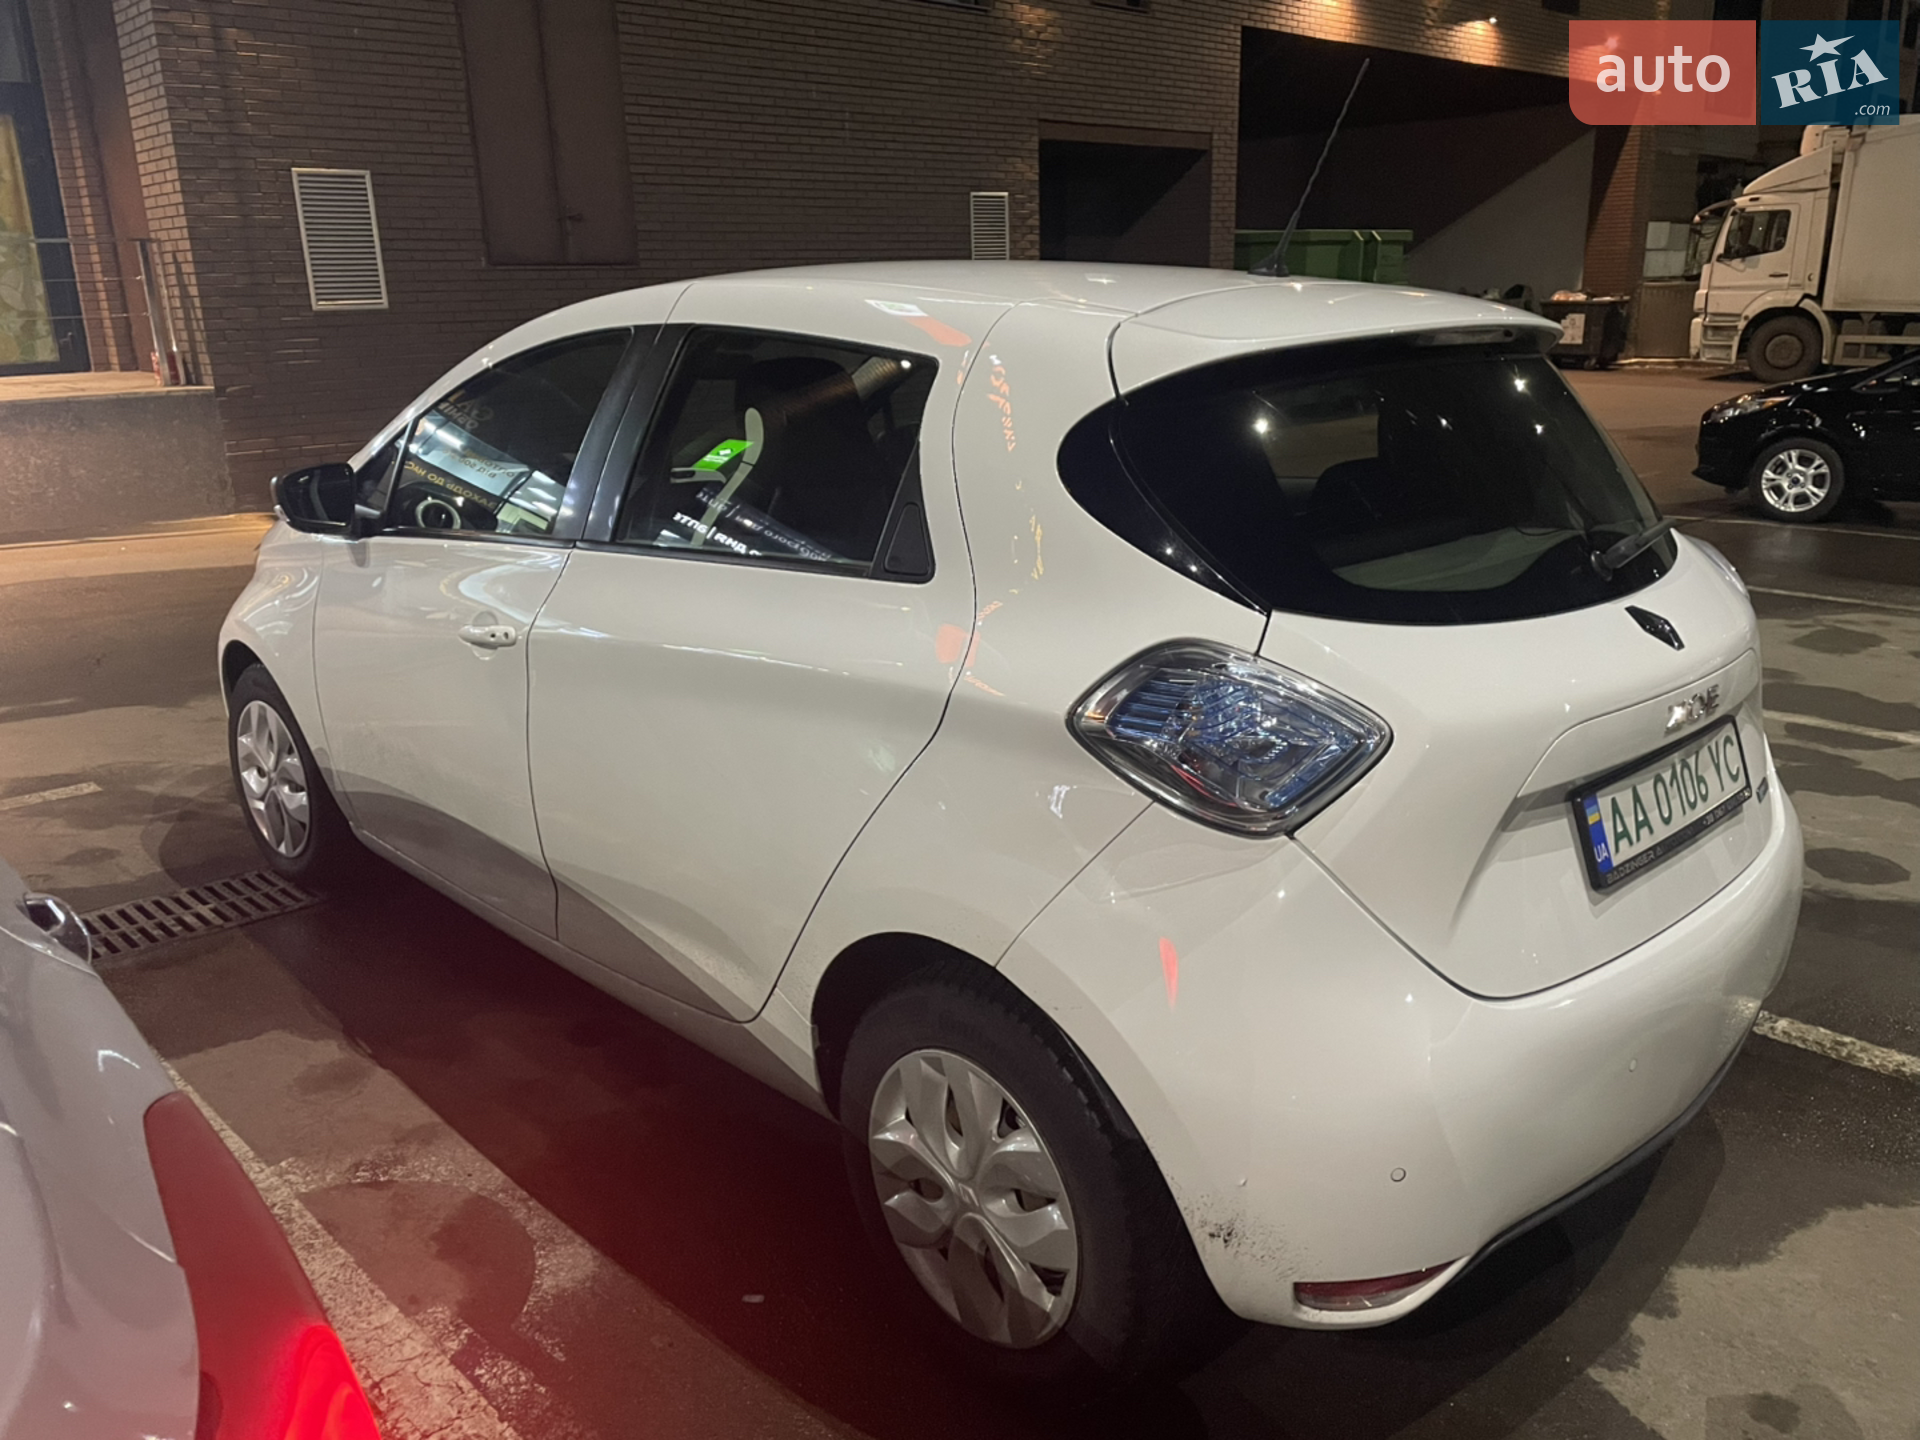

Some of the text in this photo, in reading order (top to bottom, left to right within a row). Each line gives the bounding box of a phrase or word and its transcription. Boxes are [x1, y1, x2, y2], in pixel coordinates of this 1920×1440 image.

[1611, 785, 1654, 854] AA
[1652, 752, 1709, 826] 0106
[1594, 843, 1609, 862] UA
